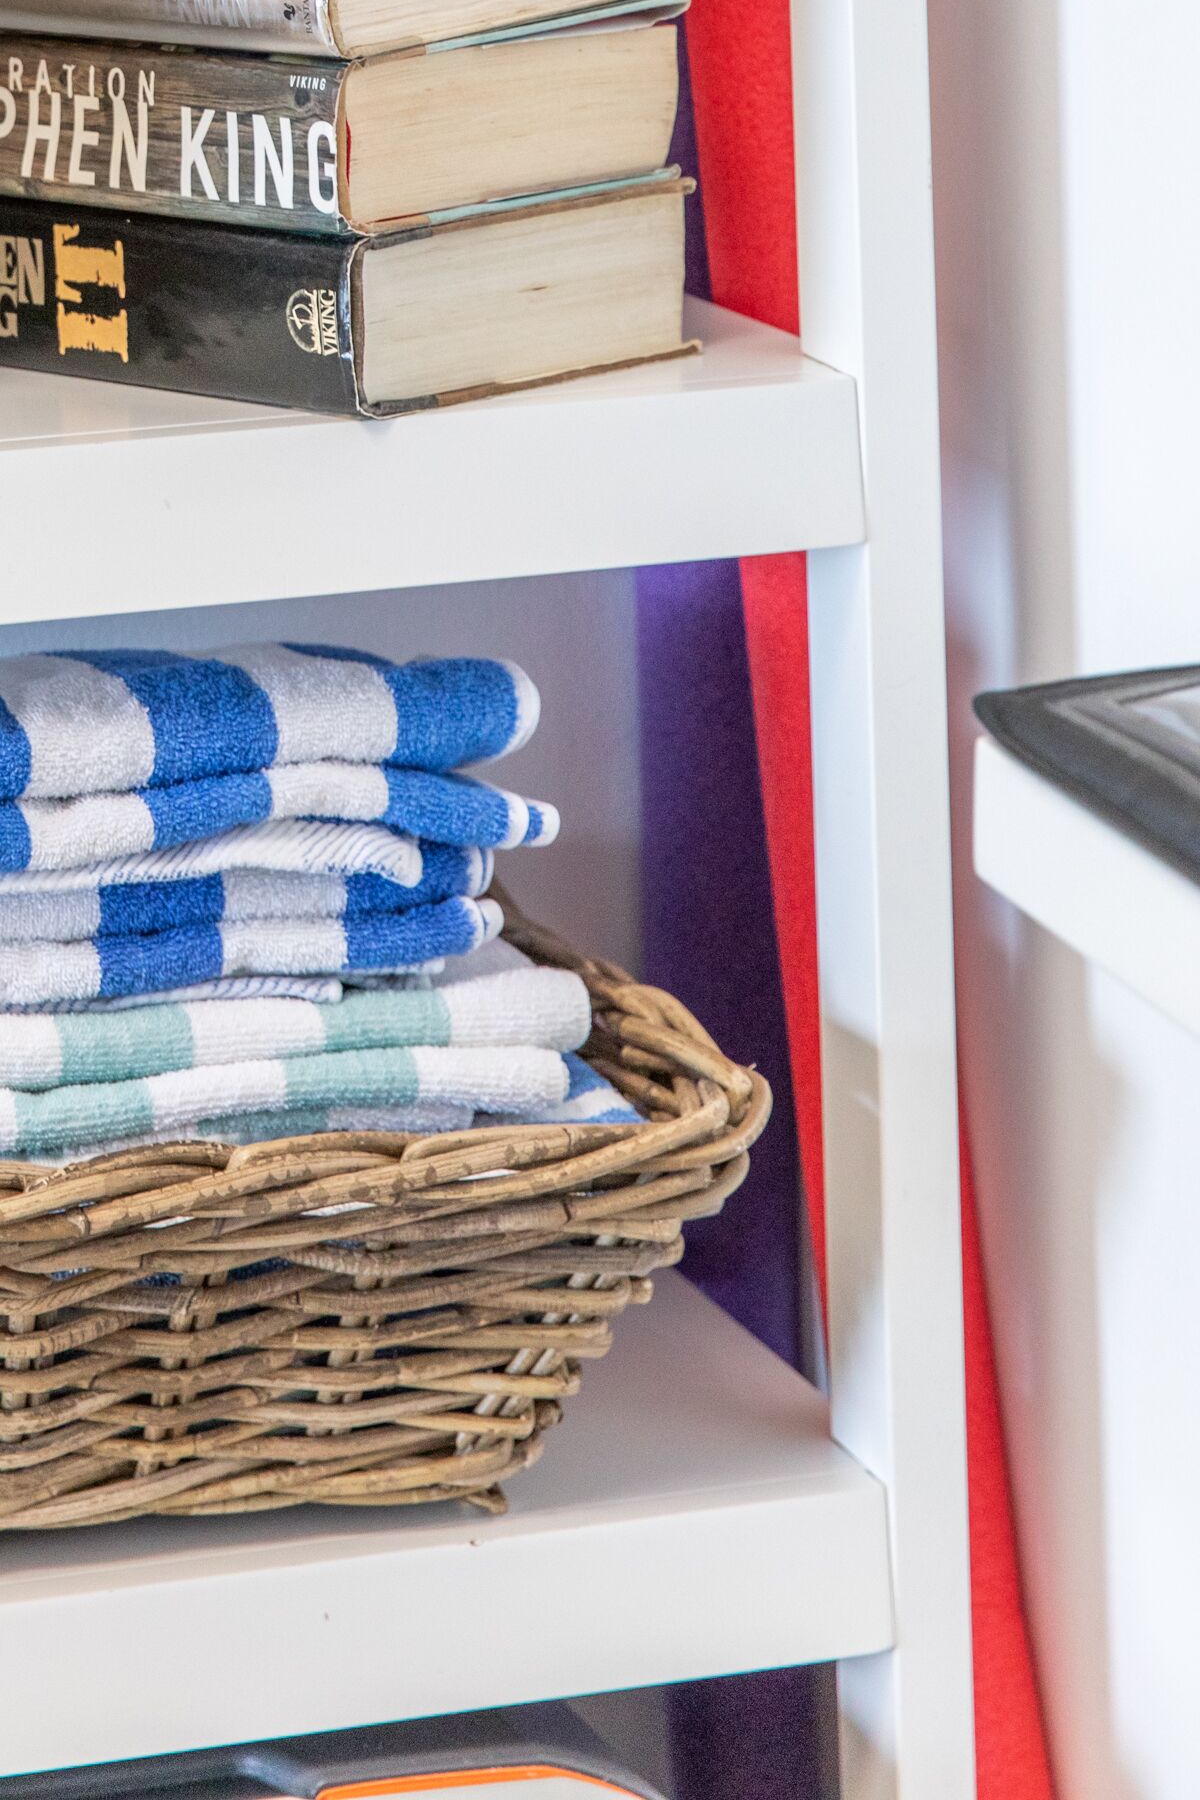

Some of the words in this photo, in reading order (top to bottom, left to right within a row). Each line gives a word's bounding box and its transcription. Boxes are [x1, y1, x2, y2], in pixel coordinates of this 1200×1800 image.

[289, 75, 326, 90] VIKING
[180, 106, 338, 214] KING
[52, 223, 129, 363] IT
[320, 289, 339, 356] VIKING
